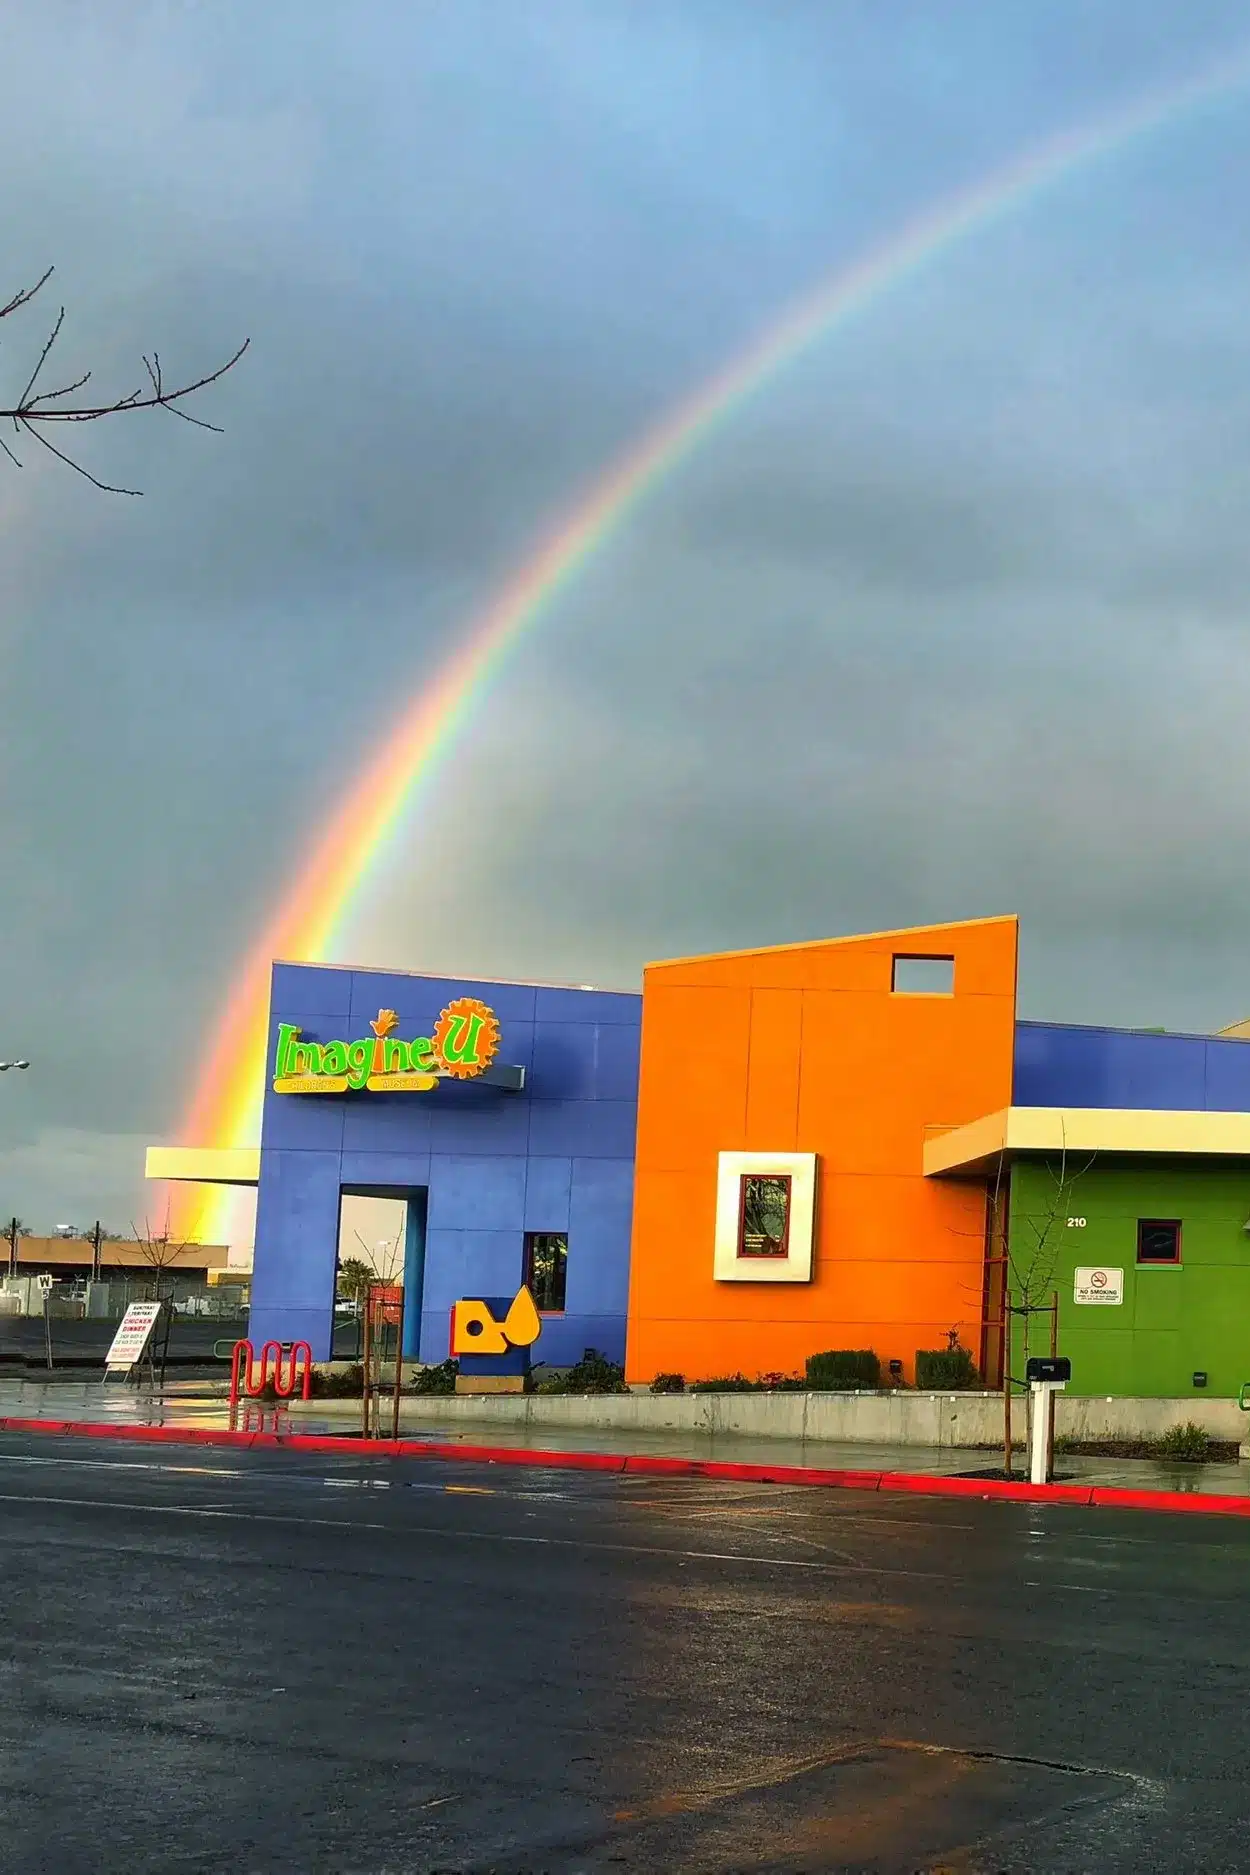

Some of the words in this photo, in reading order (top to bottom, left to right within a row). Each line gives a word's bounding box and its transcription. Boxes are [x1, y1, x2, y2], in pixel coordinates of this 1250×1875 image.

[273, 1009, 434, 1089] Imagine
[1067, 1217, 1087, 1228] 210
[39, 1276, 50, 1287] W
